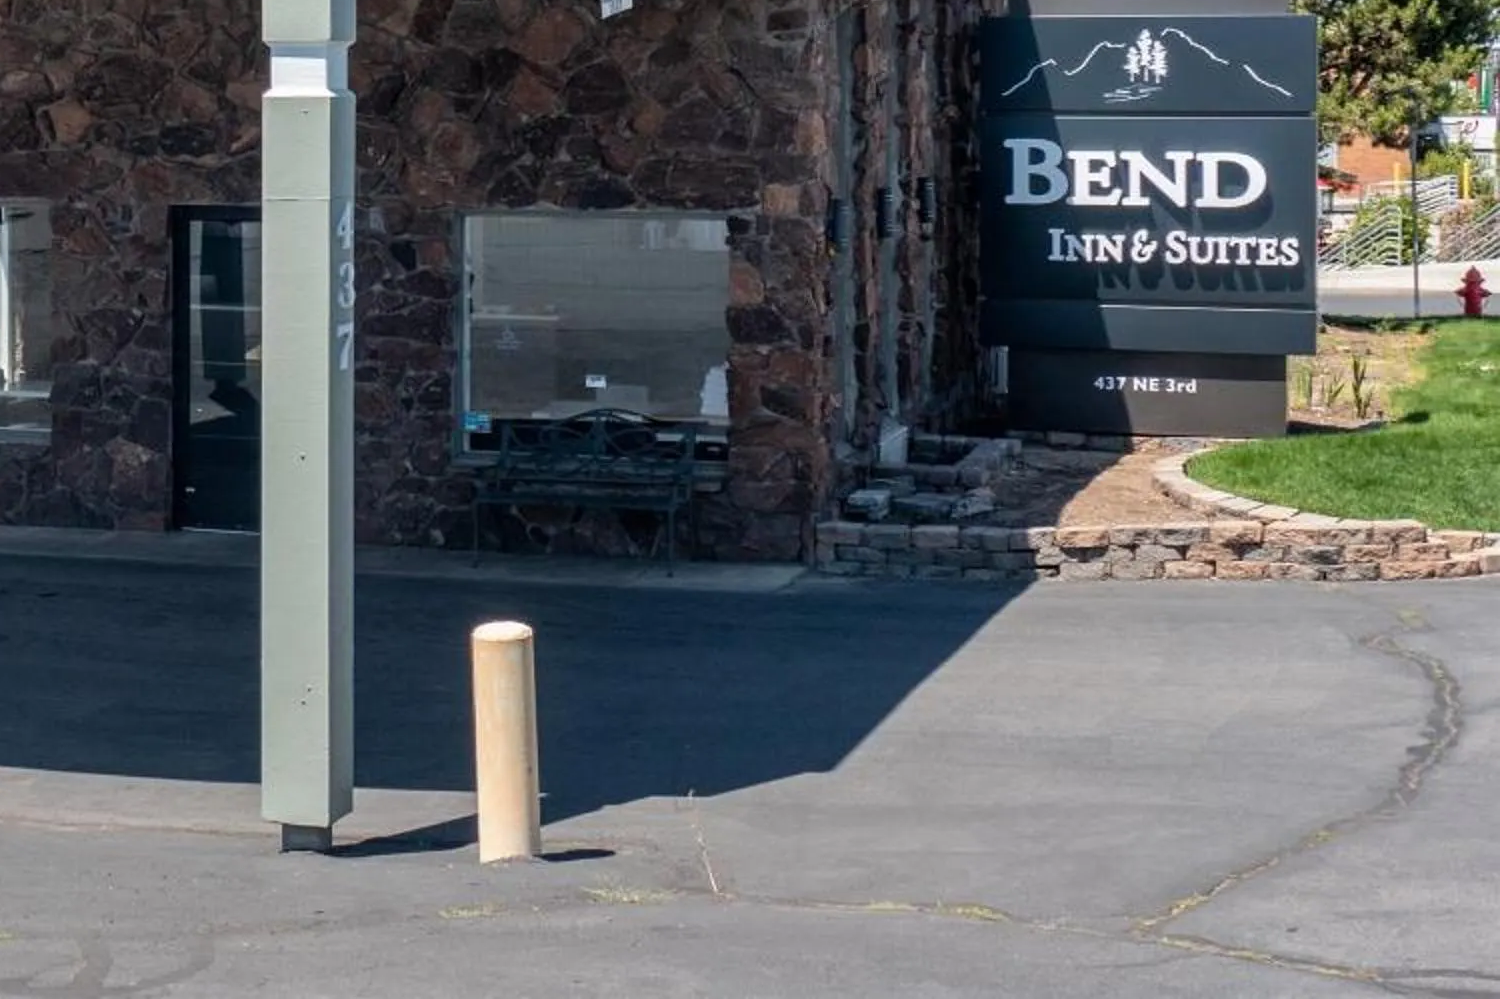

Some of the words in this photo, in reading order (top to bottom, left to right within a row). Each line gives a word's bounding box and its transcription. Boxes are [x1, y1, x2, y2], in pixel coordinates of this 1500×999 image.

[1003, 138, 1267, 208] BEND
[1047, 228, 1126, 263] INN
[1130, 229, 1158, 263] &
[1165, 230, 1300, 266] SUITES
[336, 201, 355, 371] 437
[1093, 376, 1125, 391] 437
[1133, 377, 1160, 392] NE
[1165, 378, 1197, 394] 3rd
